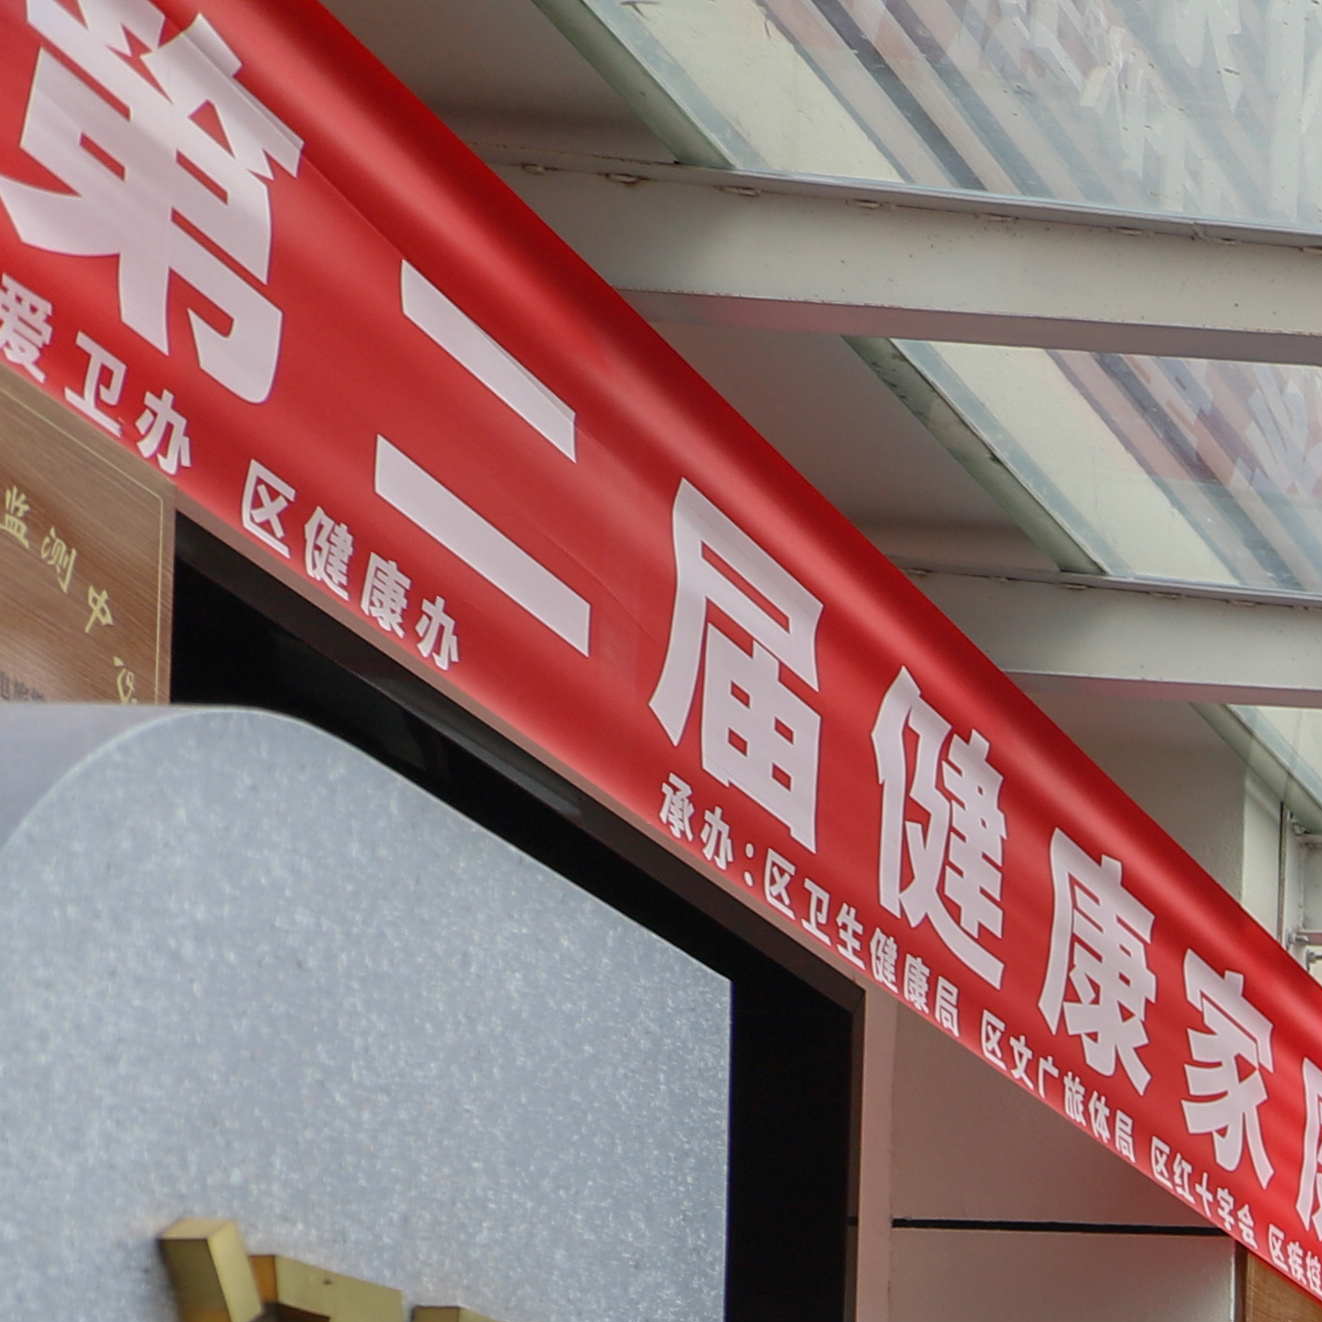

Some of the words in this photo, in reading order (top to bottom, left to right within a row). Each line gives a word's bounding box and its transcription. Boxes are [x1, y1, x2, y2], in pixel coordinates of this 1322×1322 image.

[241, 459, 460, 671] 区健康办
[980, 1008, 1136, 1164] 区文广旅体局
[1151, 1135, 1258, 1250] 区红十字会
